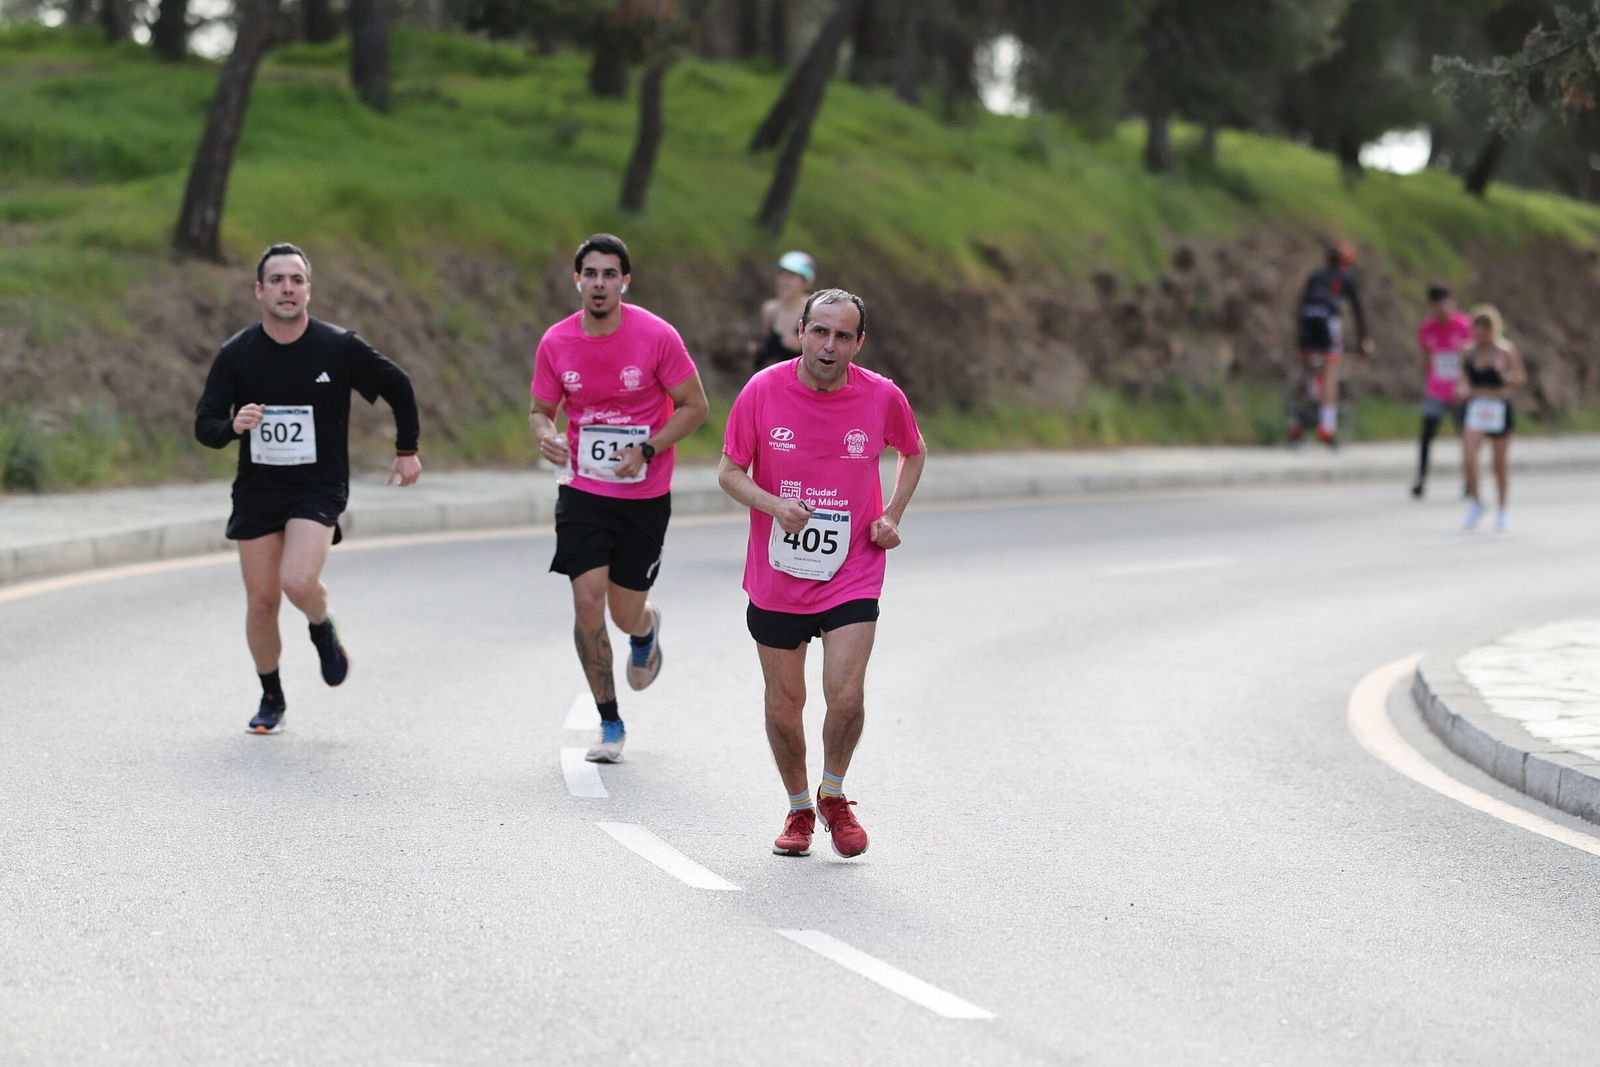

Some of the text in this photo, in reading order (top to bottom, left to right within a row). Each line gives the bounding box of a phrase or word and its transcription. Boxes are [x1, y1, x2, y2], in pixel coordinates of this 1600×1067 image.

[260, 422, 304, 443] 602
[805, 487, 837, 497] Ciudad
[818, 498, 849, 508] Málaga
[783, 527, 839, 555] 405
